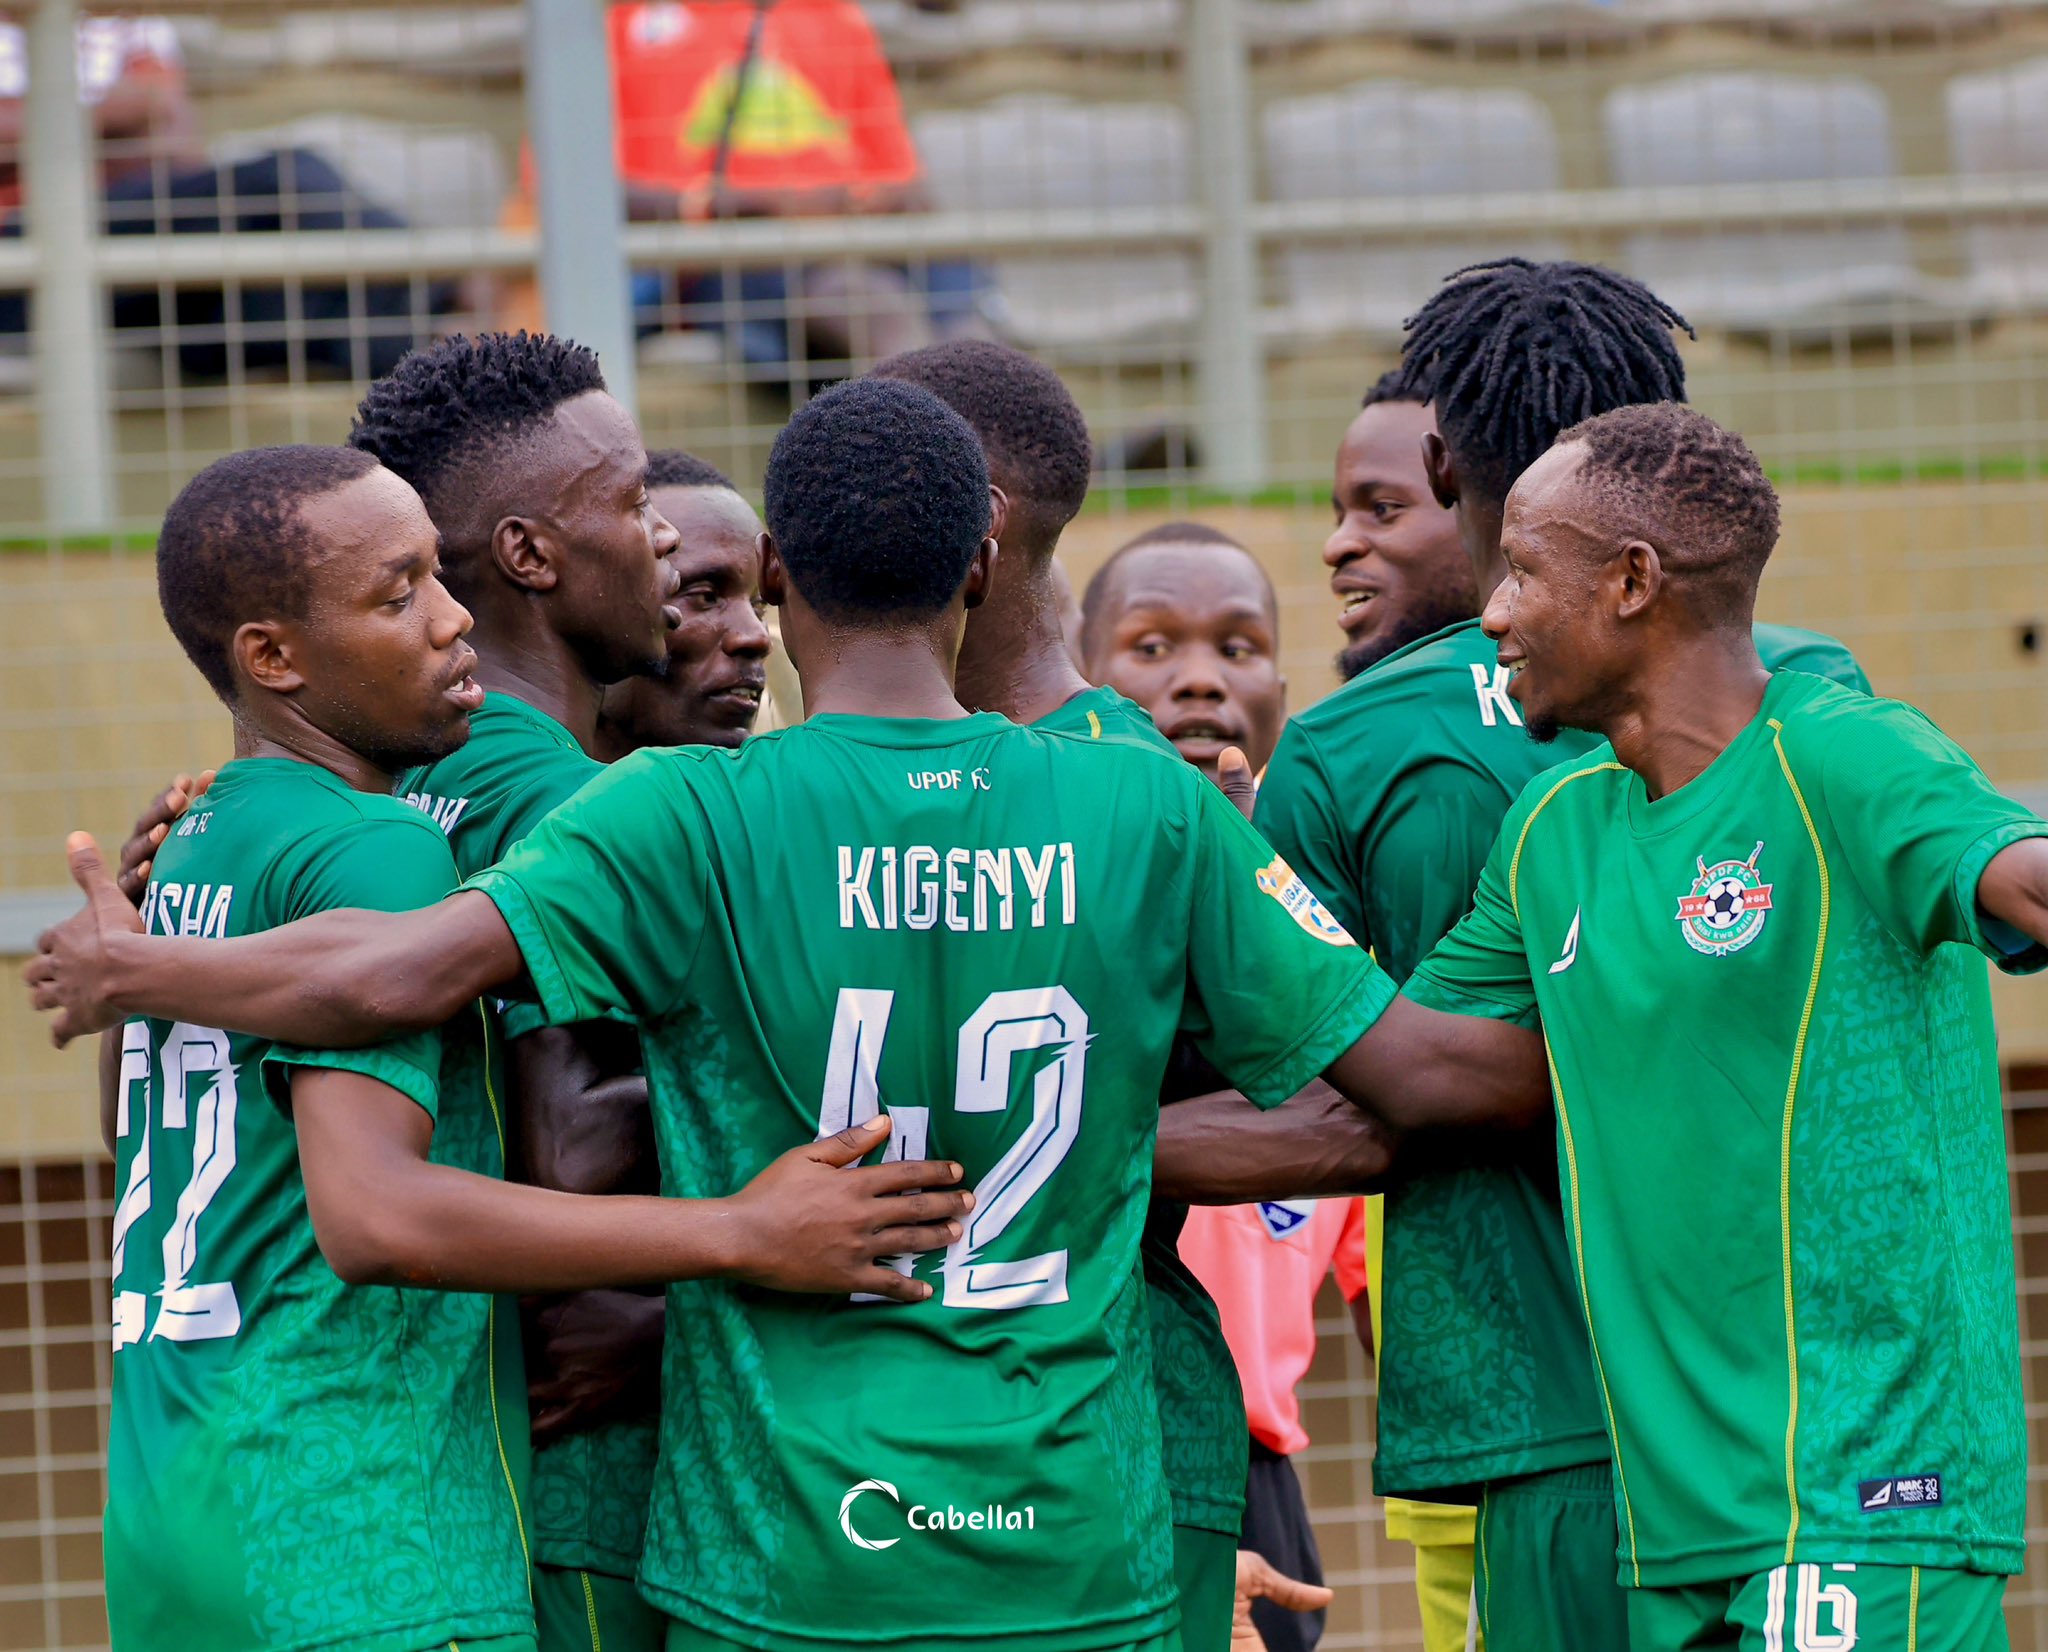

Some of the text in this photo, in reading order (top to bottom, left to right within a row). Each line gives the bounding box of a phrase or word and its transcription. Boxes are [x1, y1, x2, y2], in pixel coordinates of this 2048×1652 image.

[907, 767, 992, 790] UPDF FC
[837, 842, 1076, 932] KIGENYI
[1701, 864, 1752, 888] UPDF FC
[1763, 1563, 1860, 1652] 16
